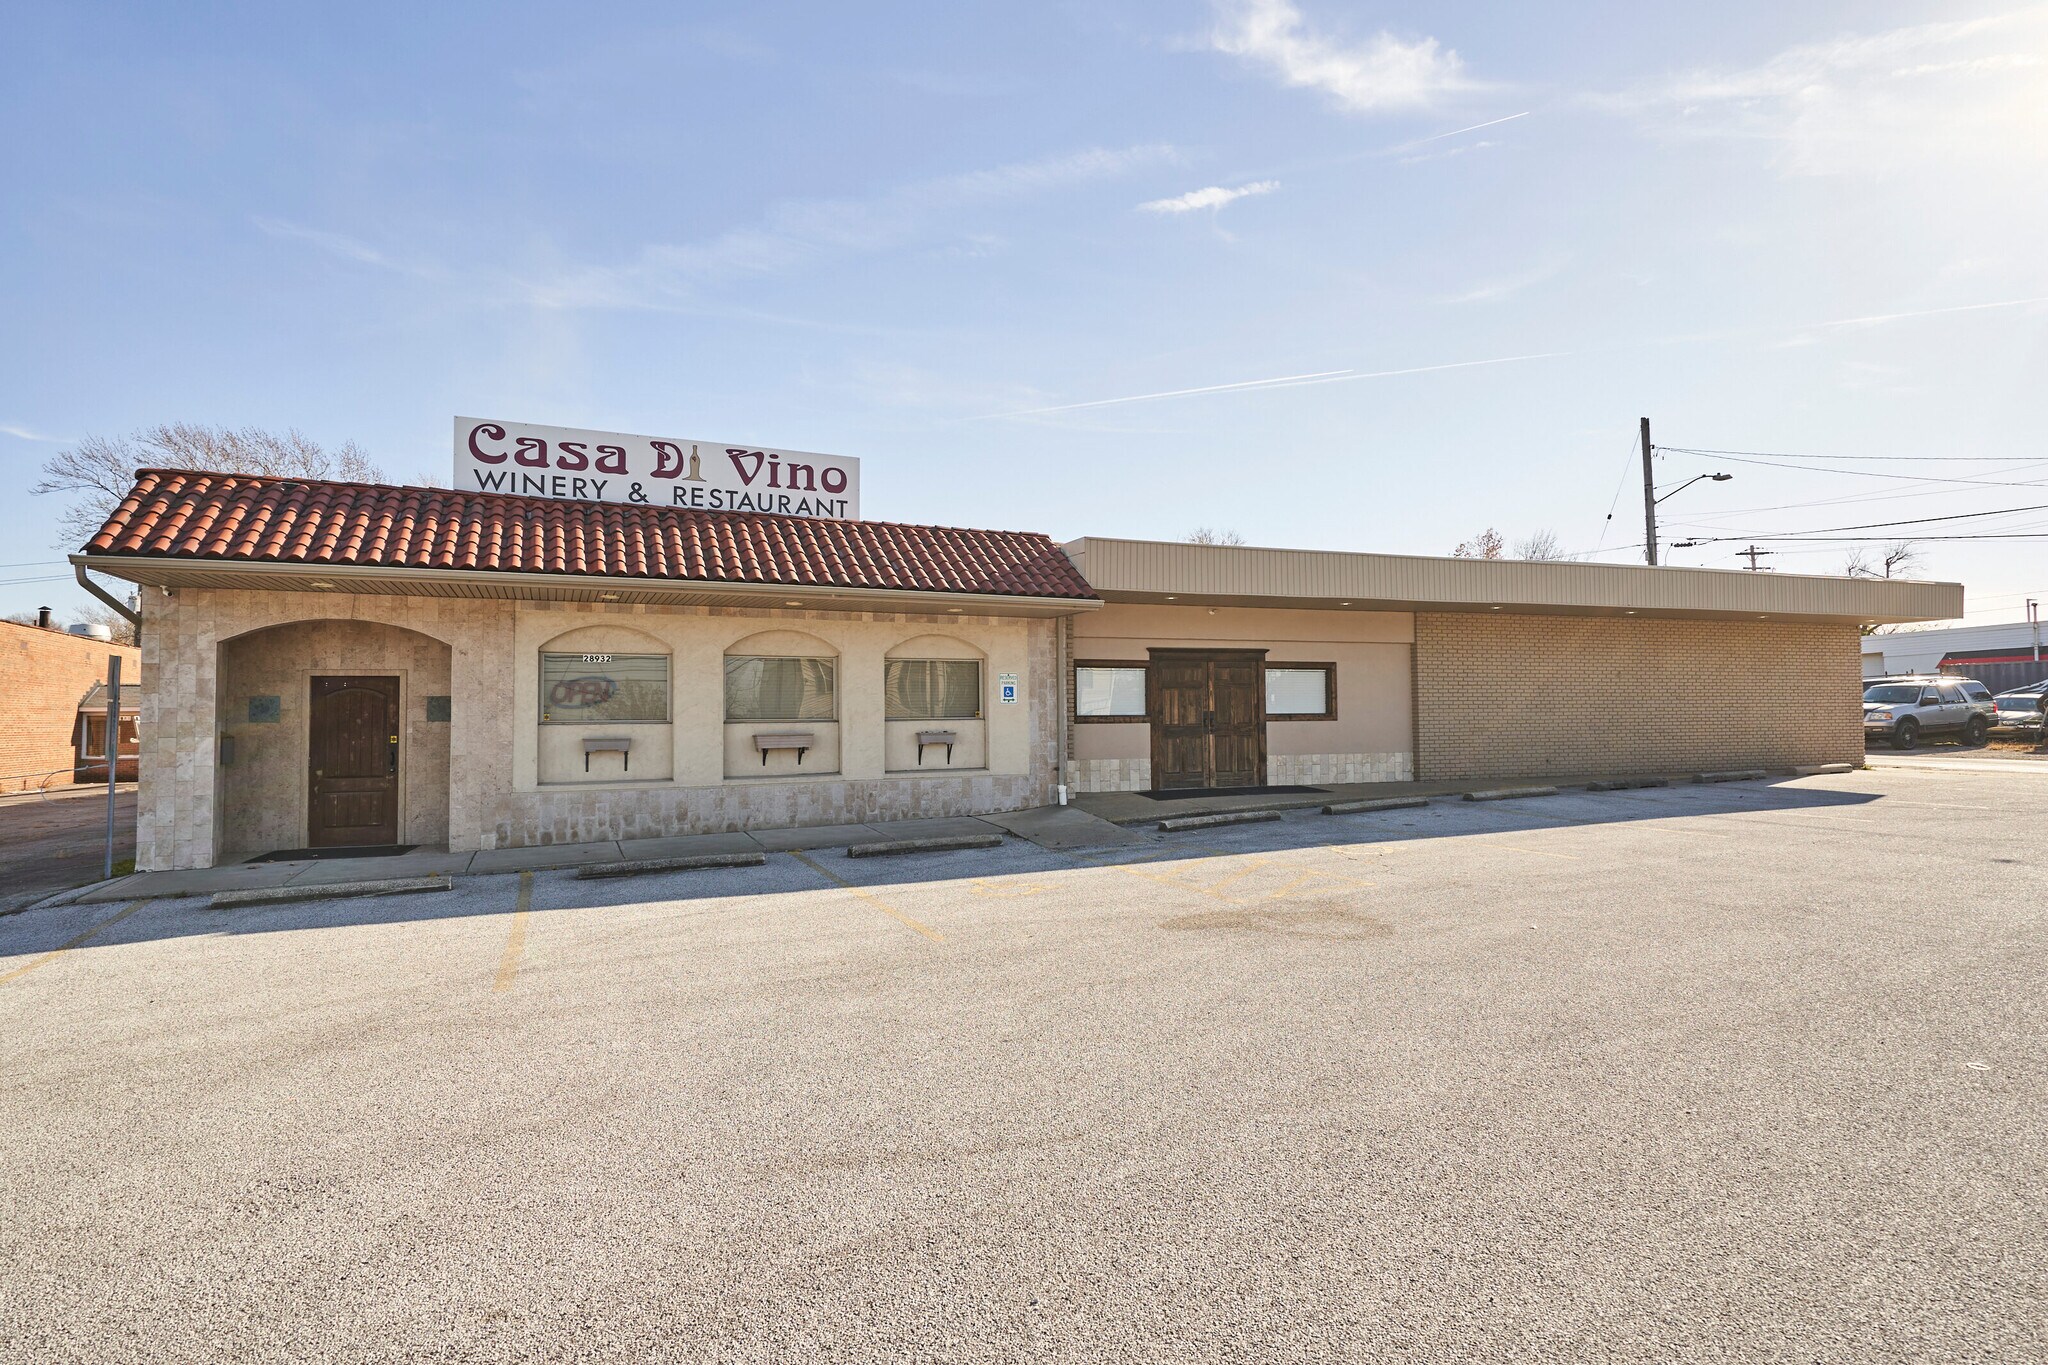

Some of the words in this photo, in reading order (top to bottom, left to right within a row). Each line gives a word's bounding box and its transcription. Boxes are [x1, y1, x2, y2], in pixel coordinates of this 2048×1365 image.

[468, 423, 629, 475] Casa
[725, 448, 848, 494] Vino
[473, 468, 608, 500] WINERY
[628, 482, 650, 503] &
[673, 485, 848, 519] RESTAURANT
[551, 682, 610, 703] OPEN
